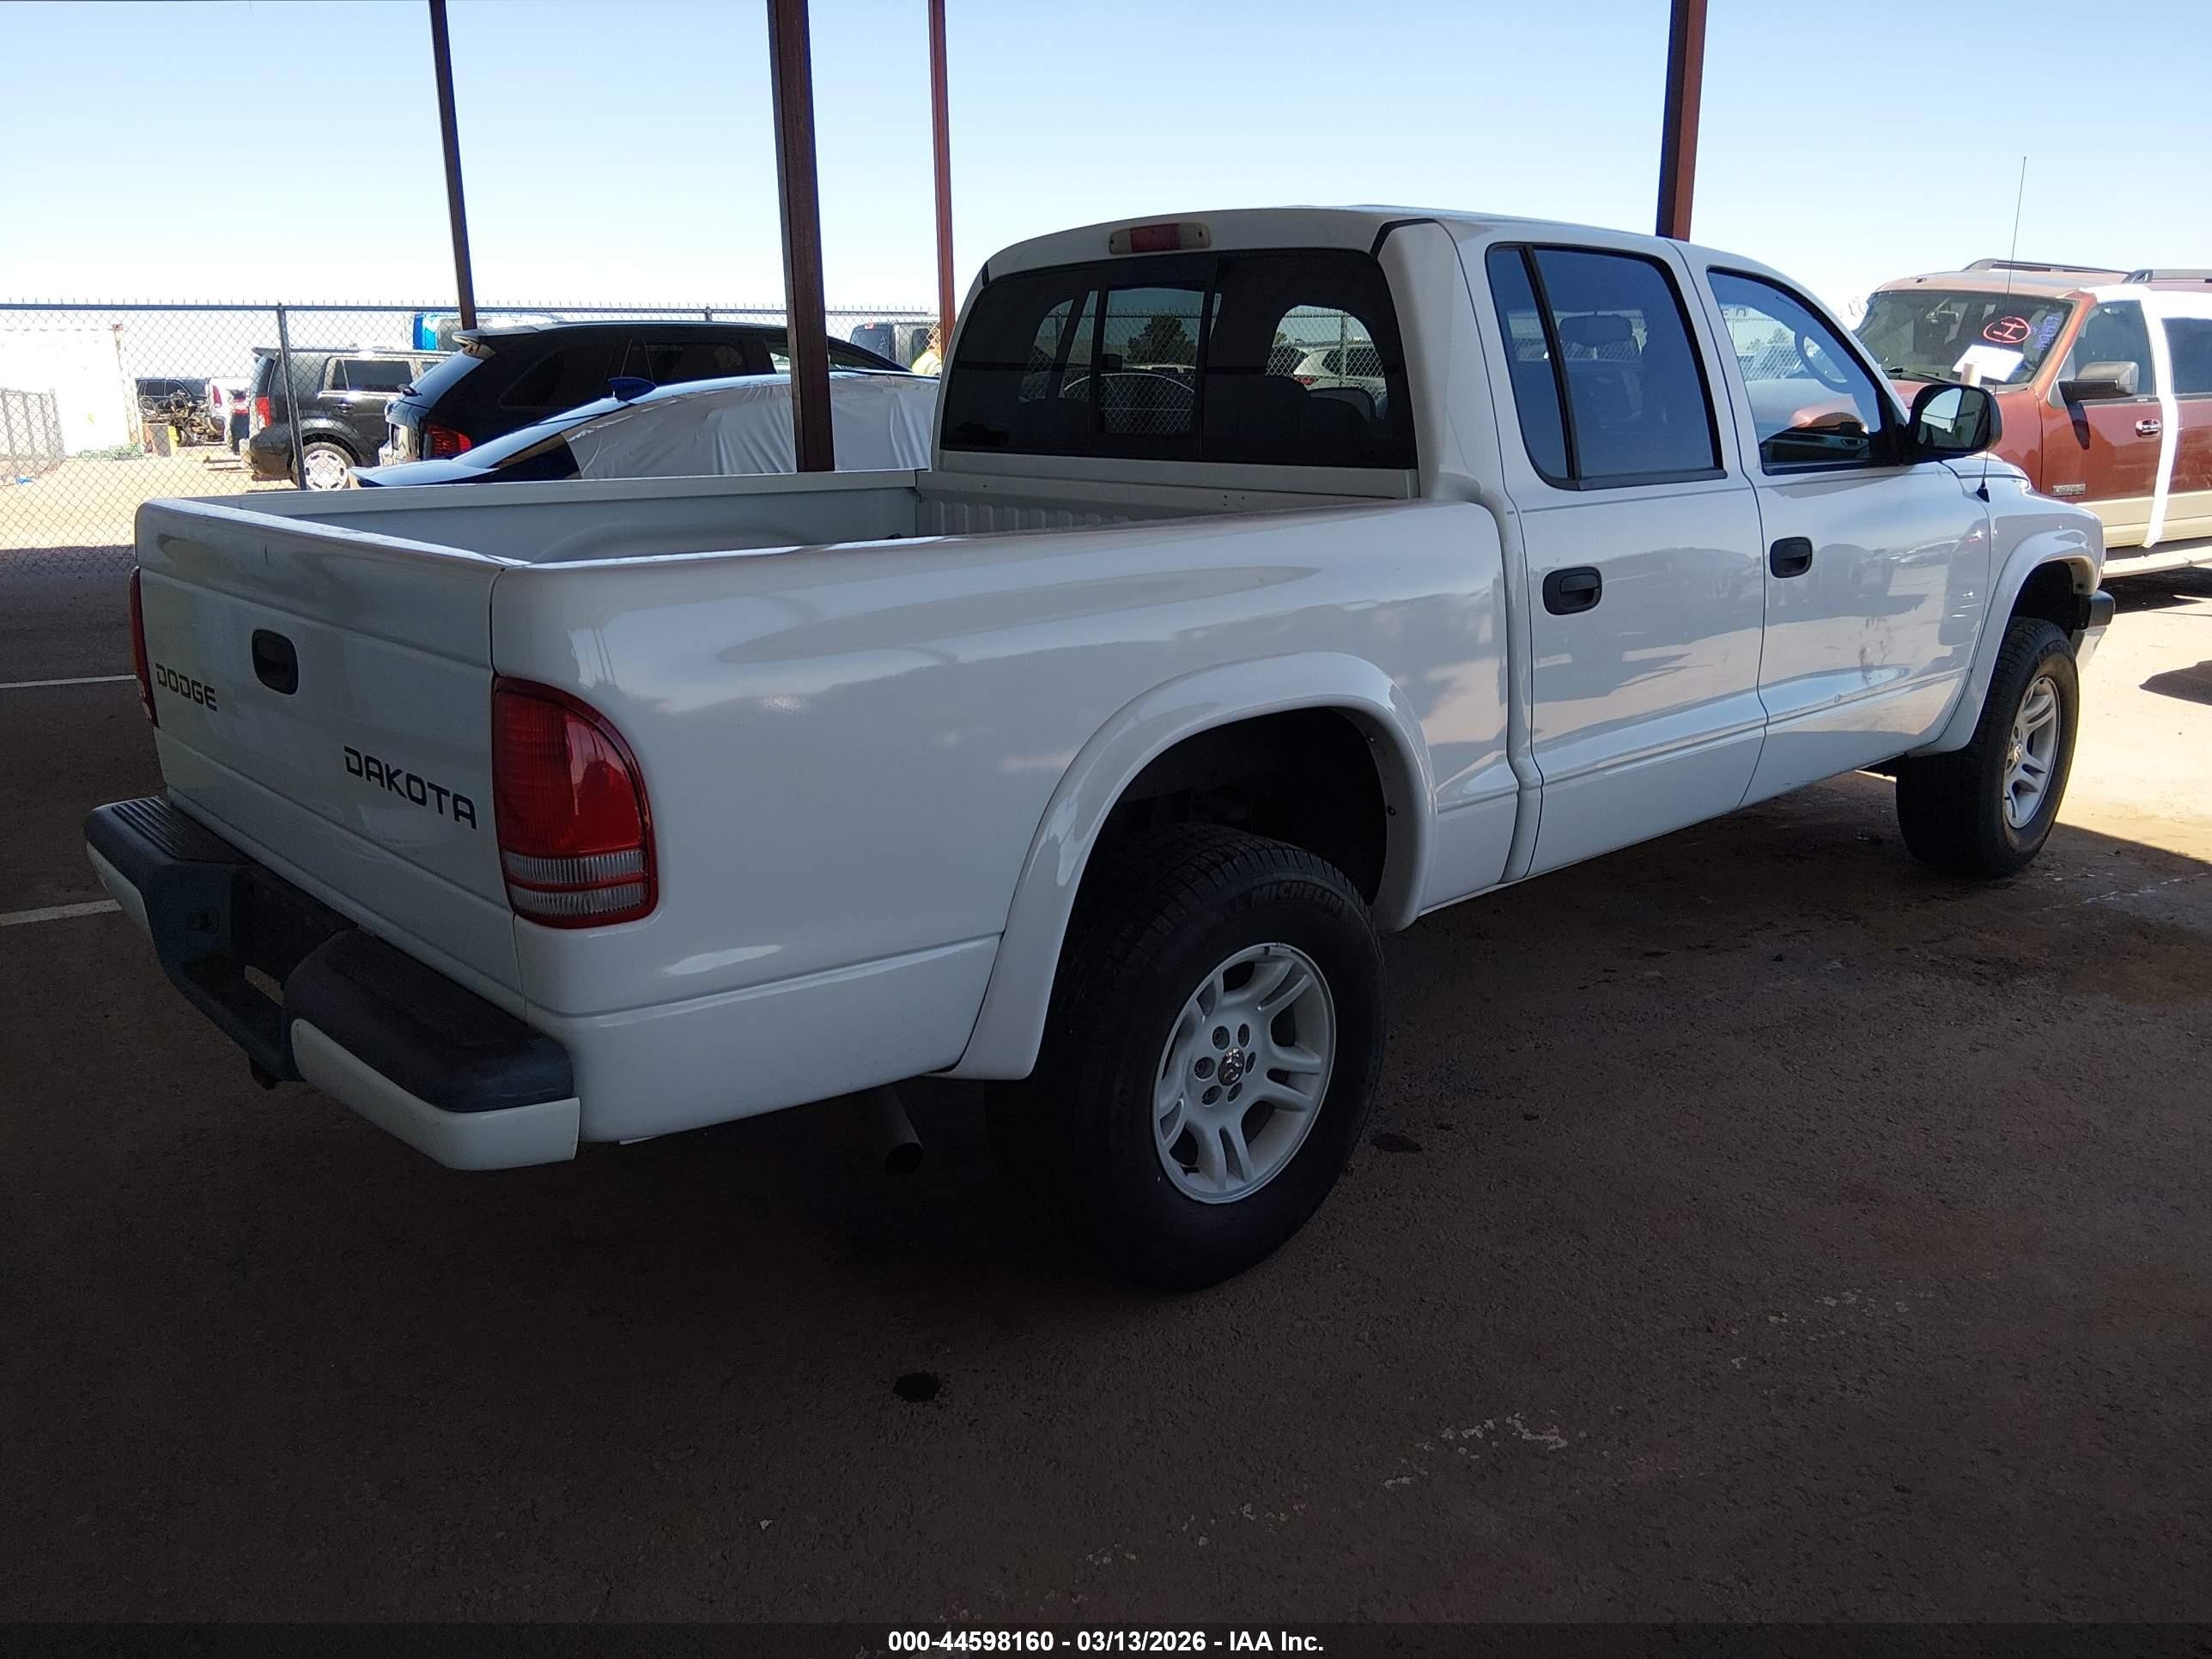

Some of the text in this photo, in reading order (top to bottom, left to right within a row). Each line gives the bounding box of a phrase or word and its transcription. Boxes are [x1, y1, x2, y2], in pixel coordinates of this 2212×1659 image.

[155, 662, 218, 713] DODGE
[343, 744, 477, 830] DAKOTA
[1250, 880, 1346, 917] MICHELIN
